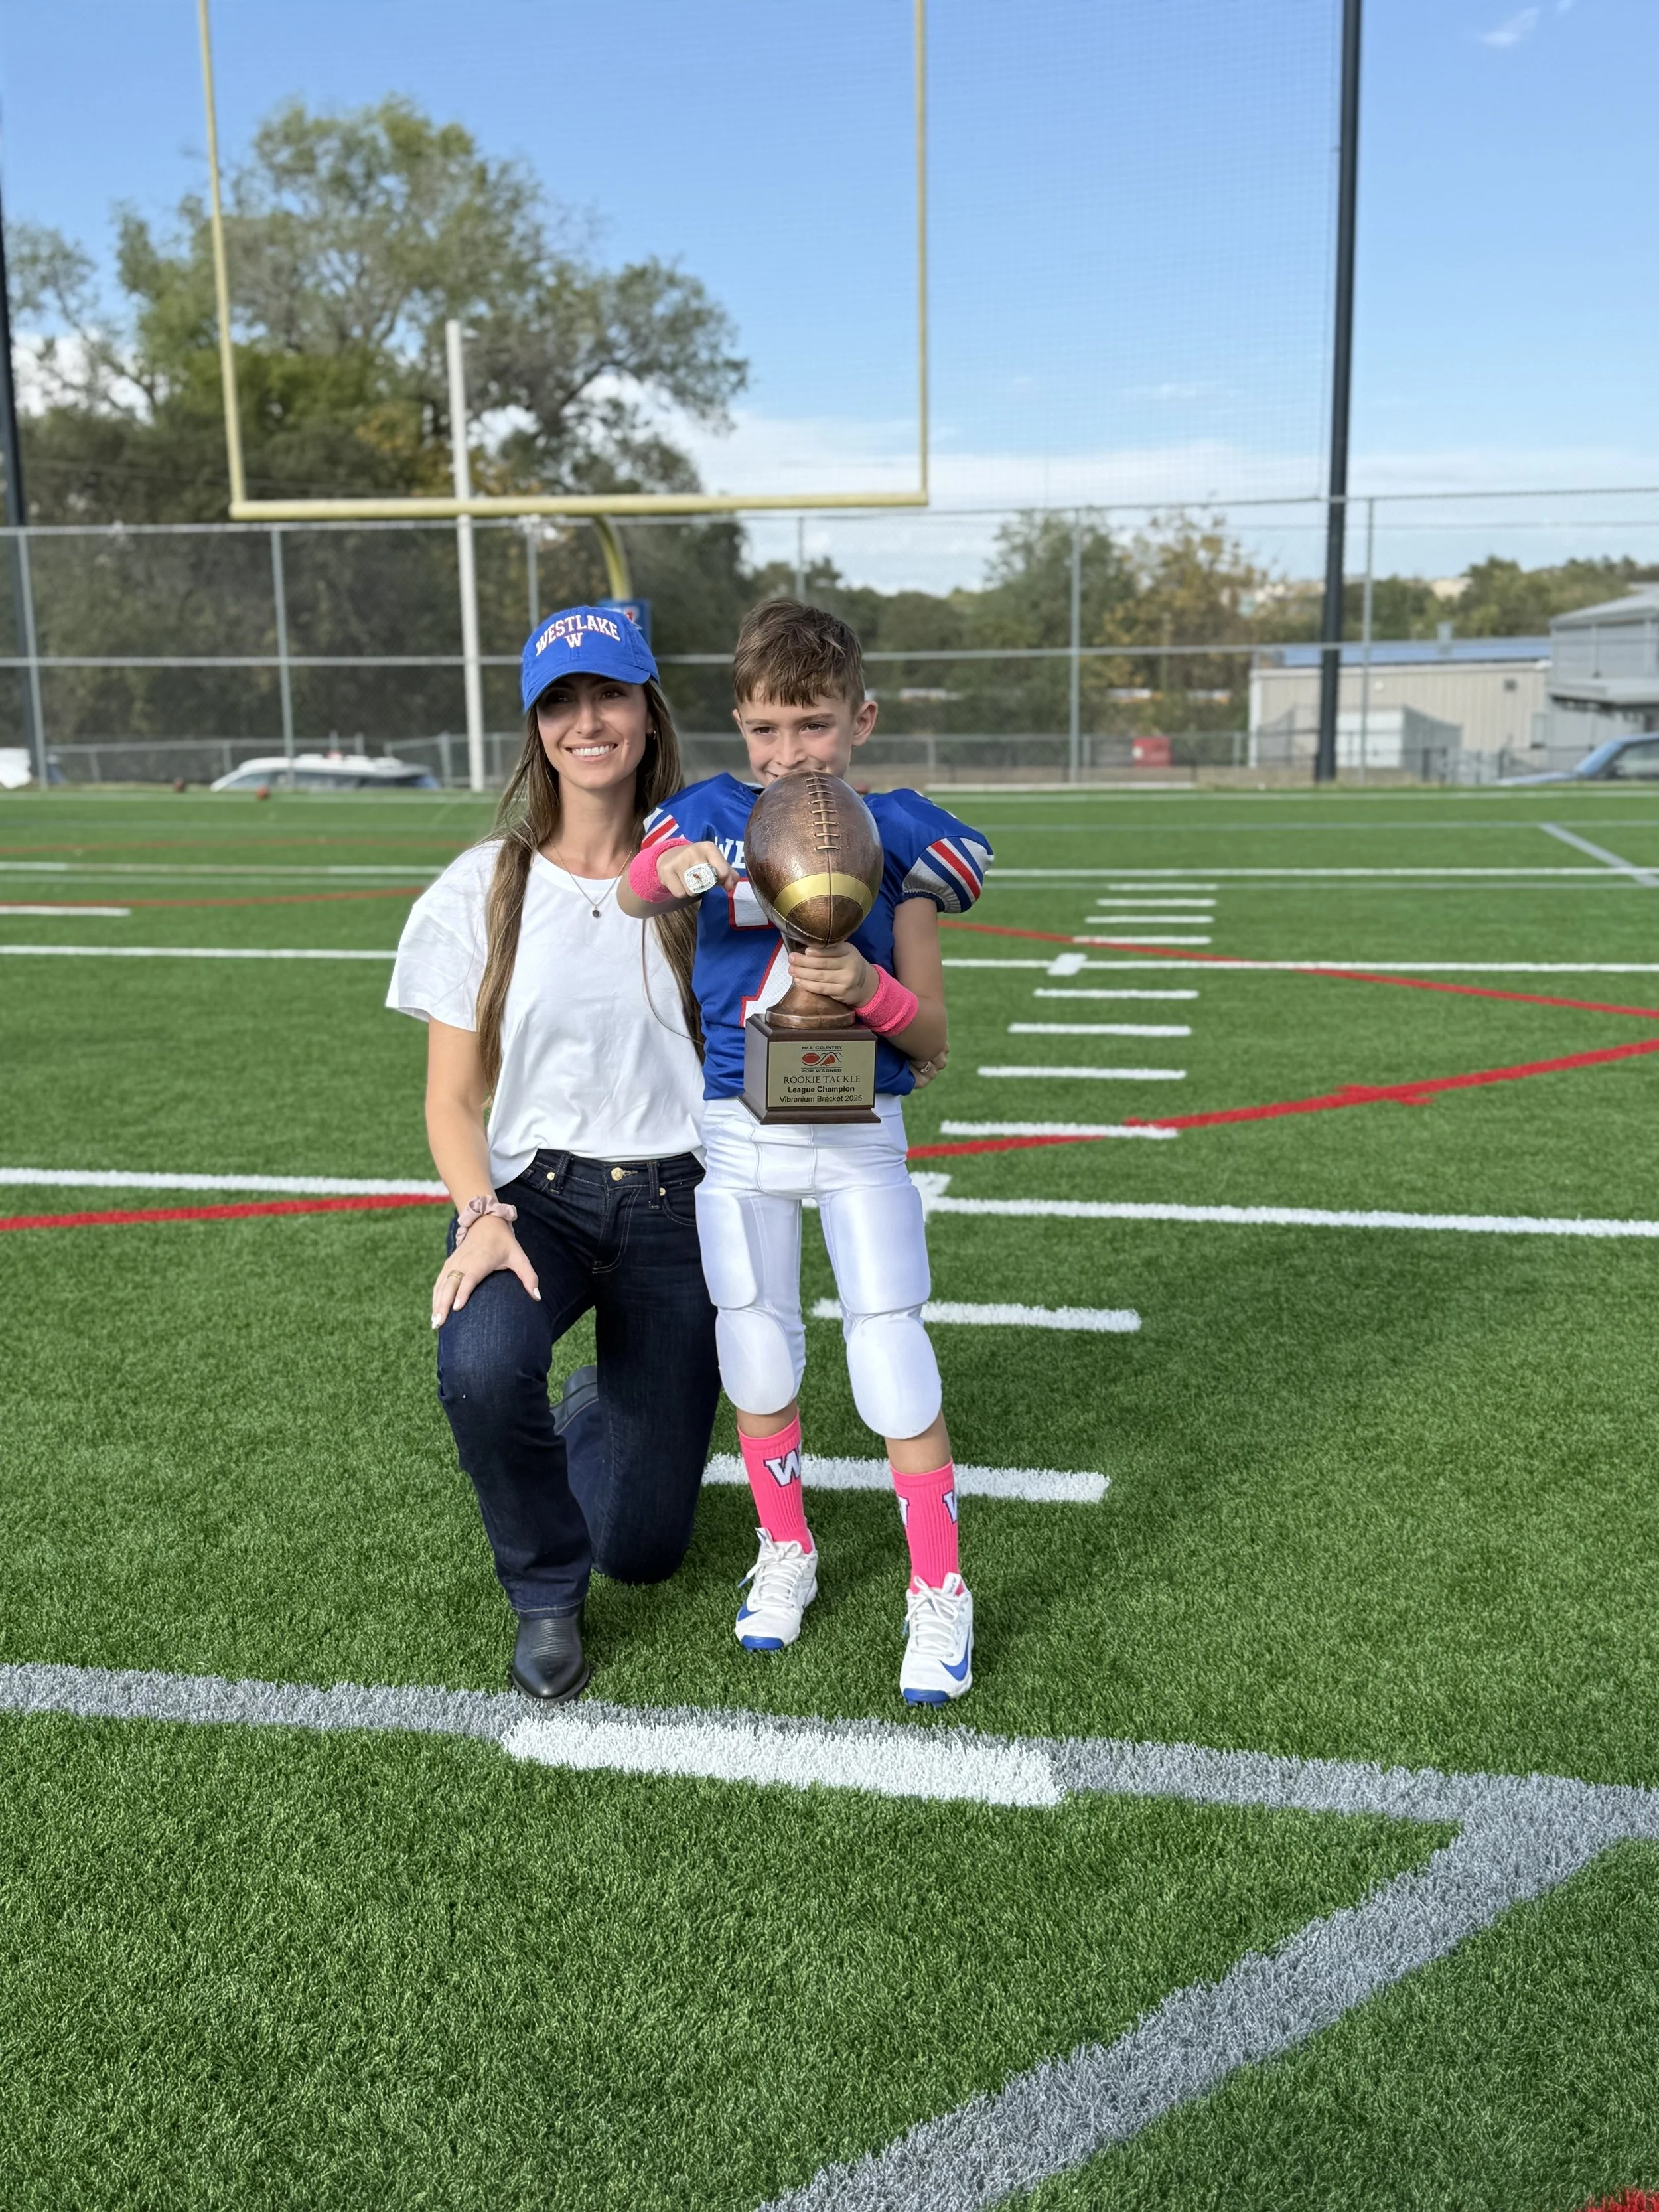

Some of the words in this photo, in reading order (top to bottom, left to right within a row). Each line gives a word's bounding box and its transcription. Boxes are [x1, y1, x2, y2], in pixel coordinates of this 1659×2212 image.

[535, 615, 621, 657] WESTLAKE
[565, 632, 583, 648] W
[817, 1085, 855, 1094] Champion
[763, 1443, 802, 1487] W
